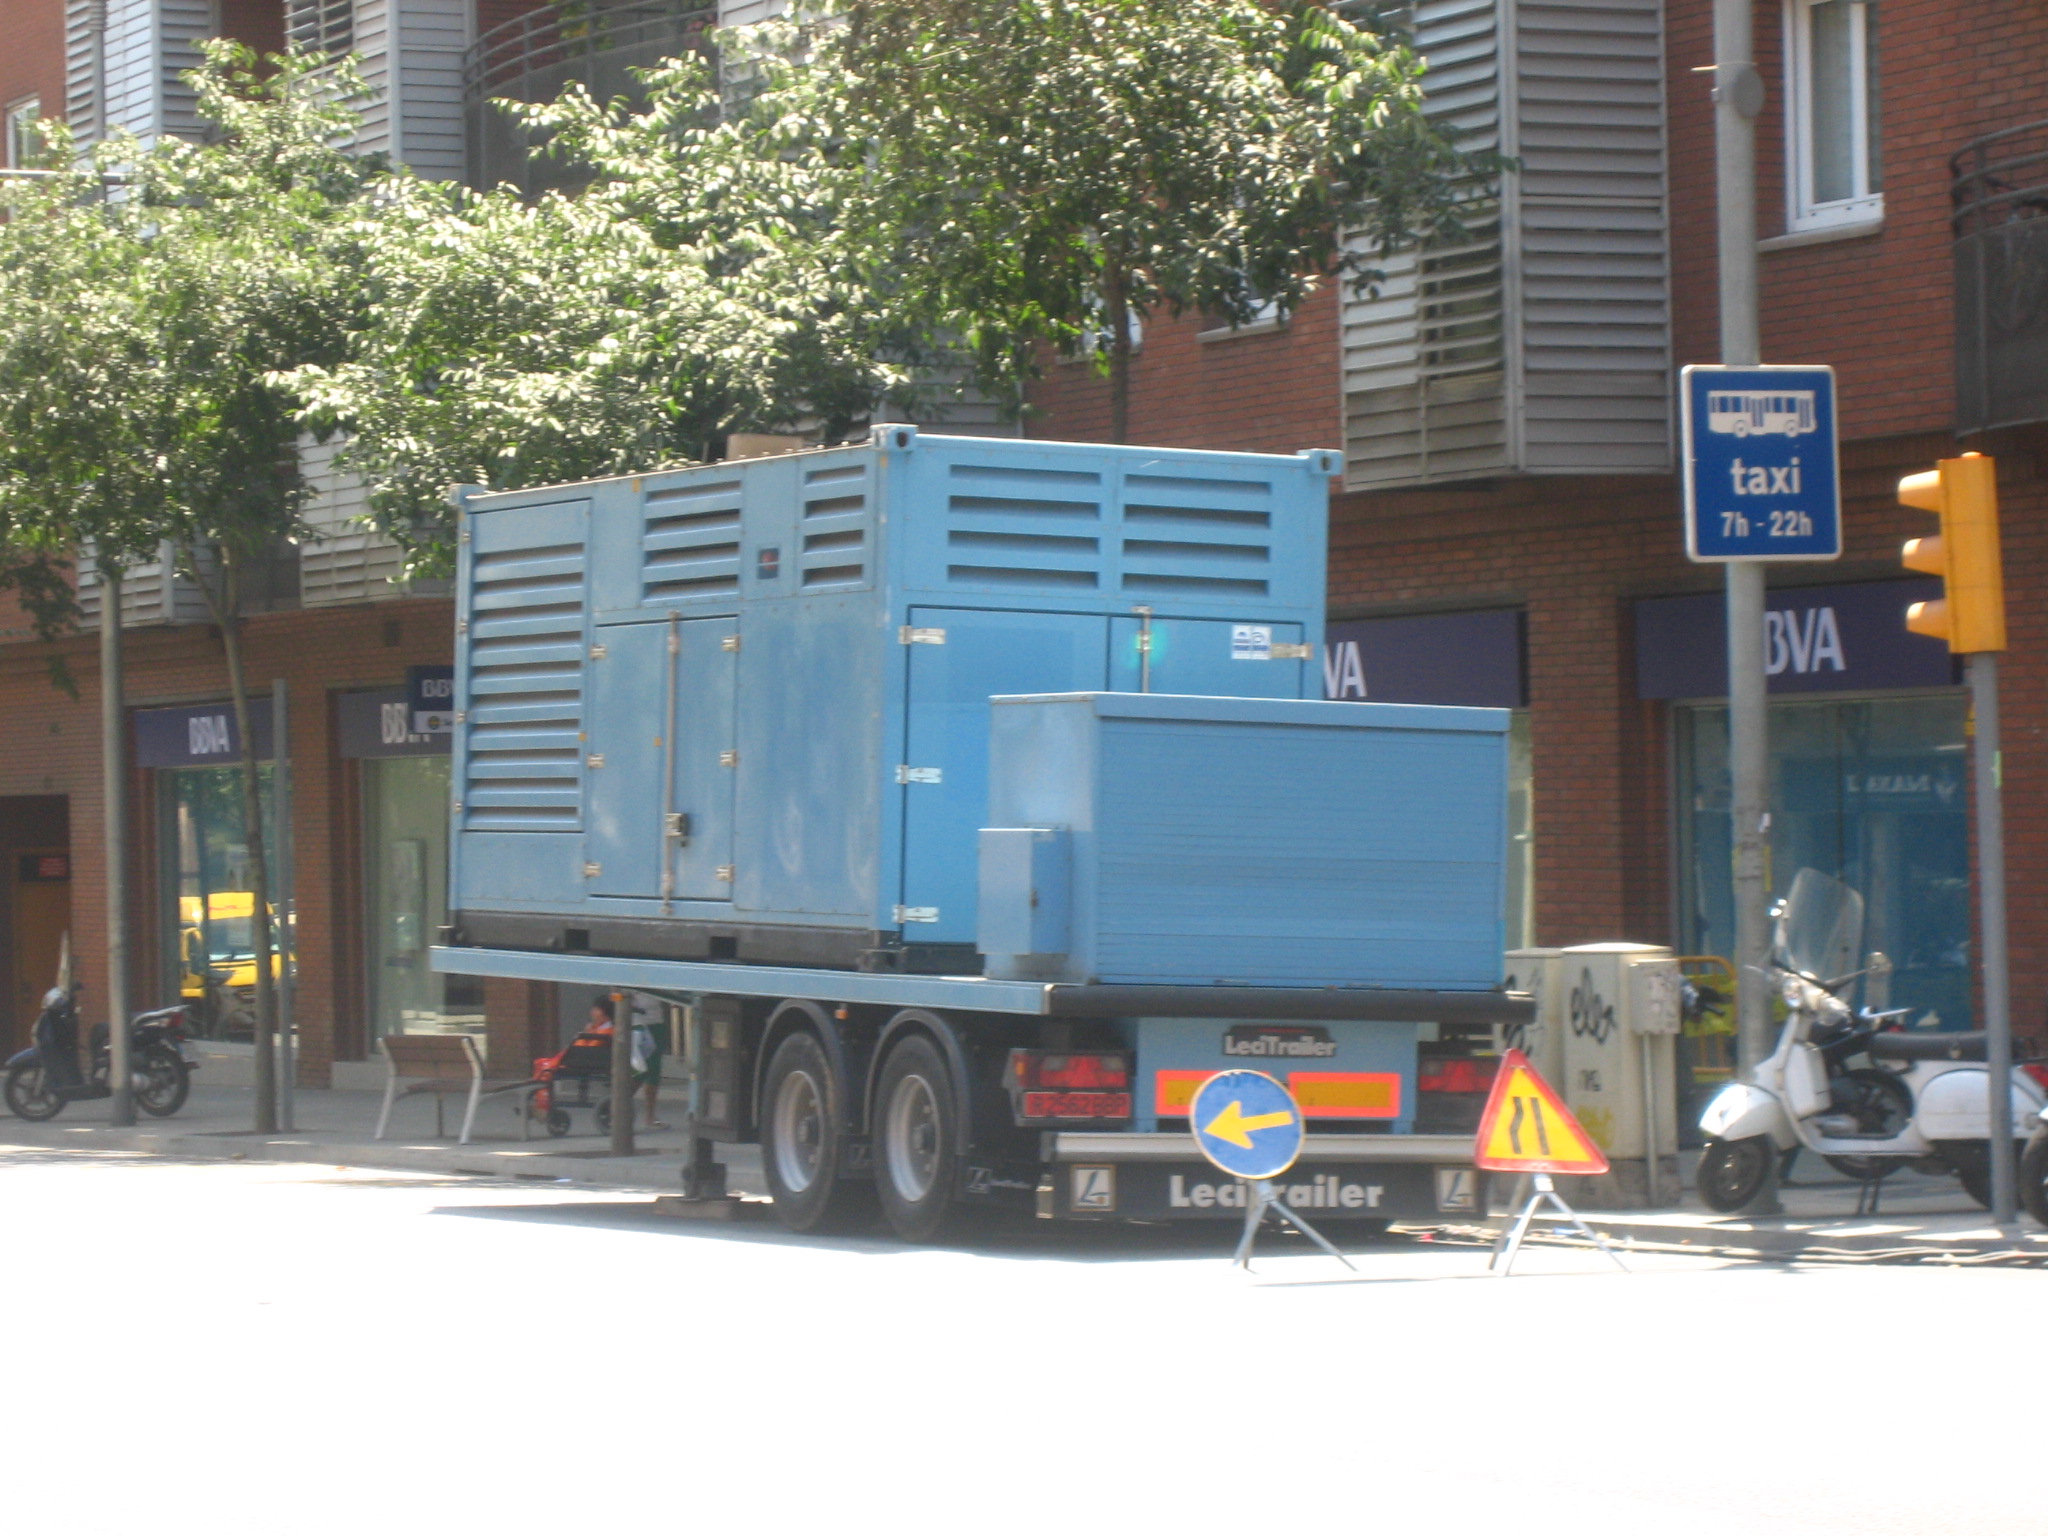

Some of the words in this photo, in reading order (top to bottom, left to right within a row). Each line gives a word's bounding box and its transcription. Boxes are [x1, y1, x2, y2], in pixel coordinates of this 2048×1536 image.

[1730, 457, 1801, 495] taxi
[1720, 511, 1749, 537] 7h
[1769, 511, 1812, 537] 22h
[1763, 607, 1846, 675] BVA
[1324, 641, 1368, 699] VA
[1170, 1174, 1384, 1208] Lecirailer
